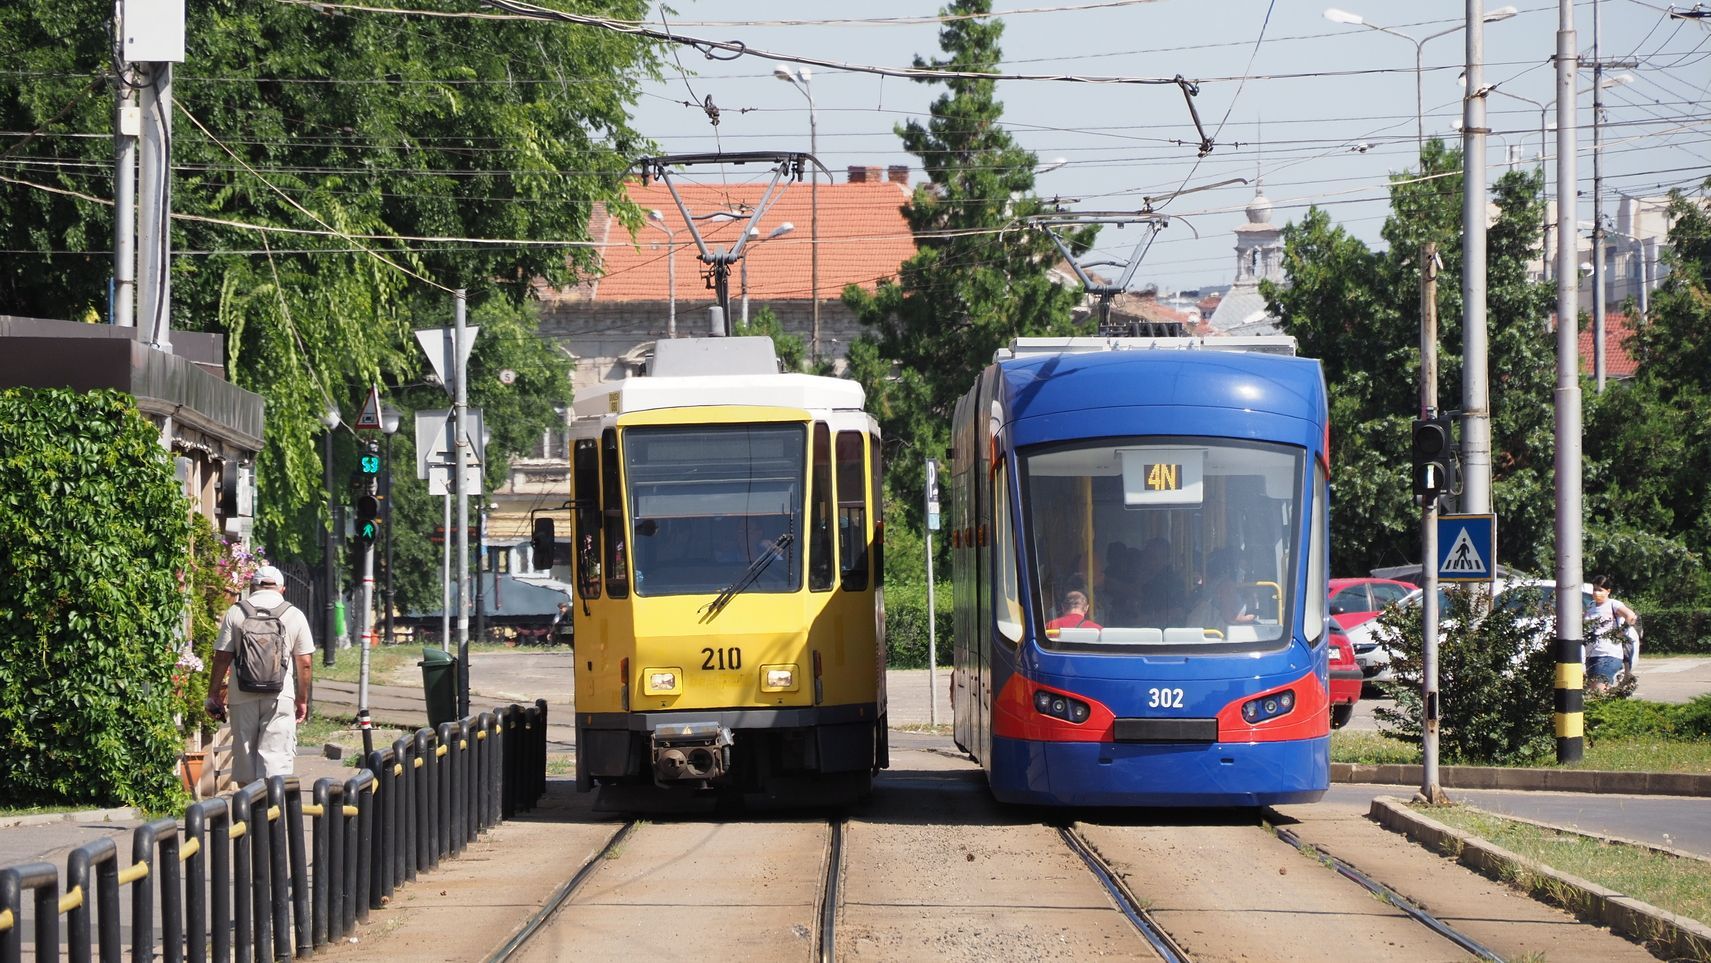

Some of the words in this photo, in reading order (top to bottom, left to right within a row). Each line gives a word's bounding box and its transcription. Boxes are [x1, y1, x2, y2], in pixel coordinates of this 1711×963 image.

[361, 457, 378, 473] 53
[928, 461, 936, 498] P
[1148, 463, 1176, 492] 4N
[701, 647, 742, 670] 210
[1148, 688, 1184, 708] 302
